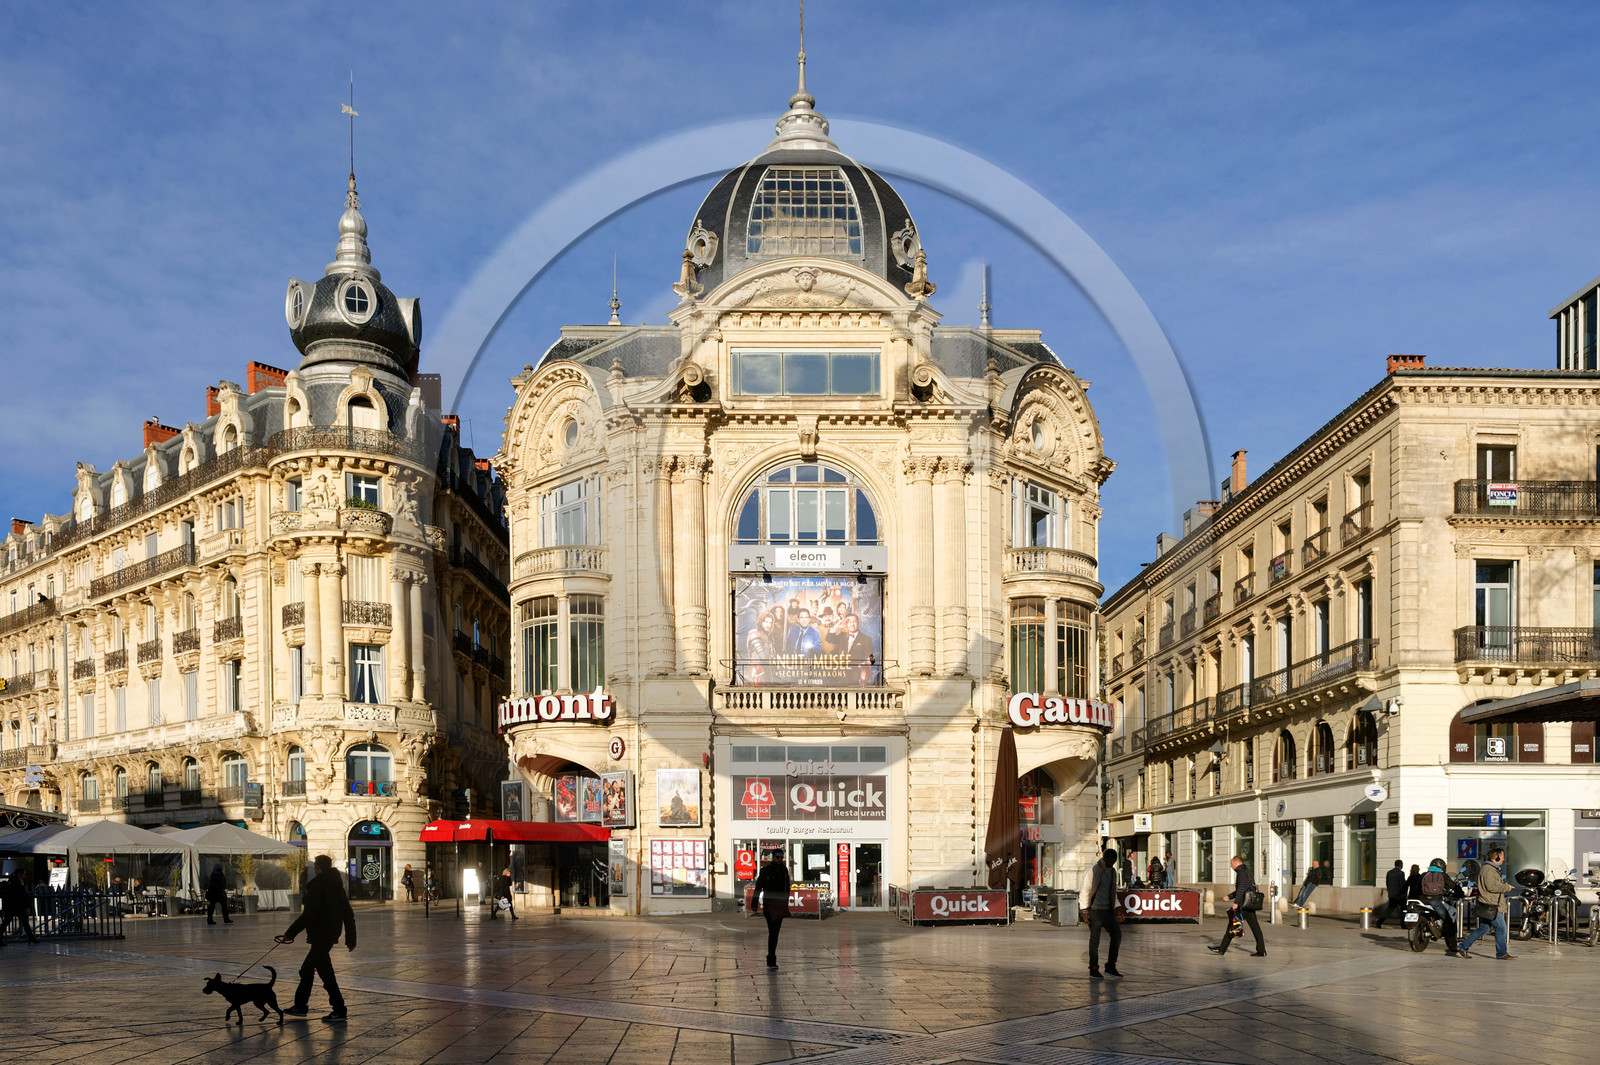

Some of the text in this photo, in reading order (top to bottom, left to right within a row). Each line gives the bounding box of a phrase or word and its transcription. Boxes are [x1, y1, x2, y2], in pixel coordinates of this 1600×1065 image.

[789, 550, 827, 561] eleom
[776, 654, 805, 670] NUIT
[813, 650, 852, 671] MUSÉE
[778, 670, 804, 678] SECRET
[809, 670, 847, 678] PHARAONS
[785, 759, 835, 778] Quick
[351, 781, 391, 795] CIC
[749, 781, 769, 801] Q
[790, 782, 885, 813] Quick
[587, 802, 600, 811] BIS
[833, 809, 885, 817] Restaurant
[361, 825, 379, 833] CIC
[766, 826, 790, 834] Quality
[793, 826, 815, 834] Burger
[739, 852, 753, 867] Q
[930, 894, 990, 916] Quick
[1124, 893, 1183, 915] Quick
